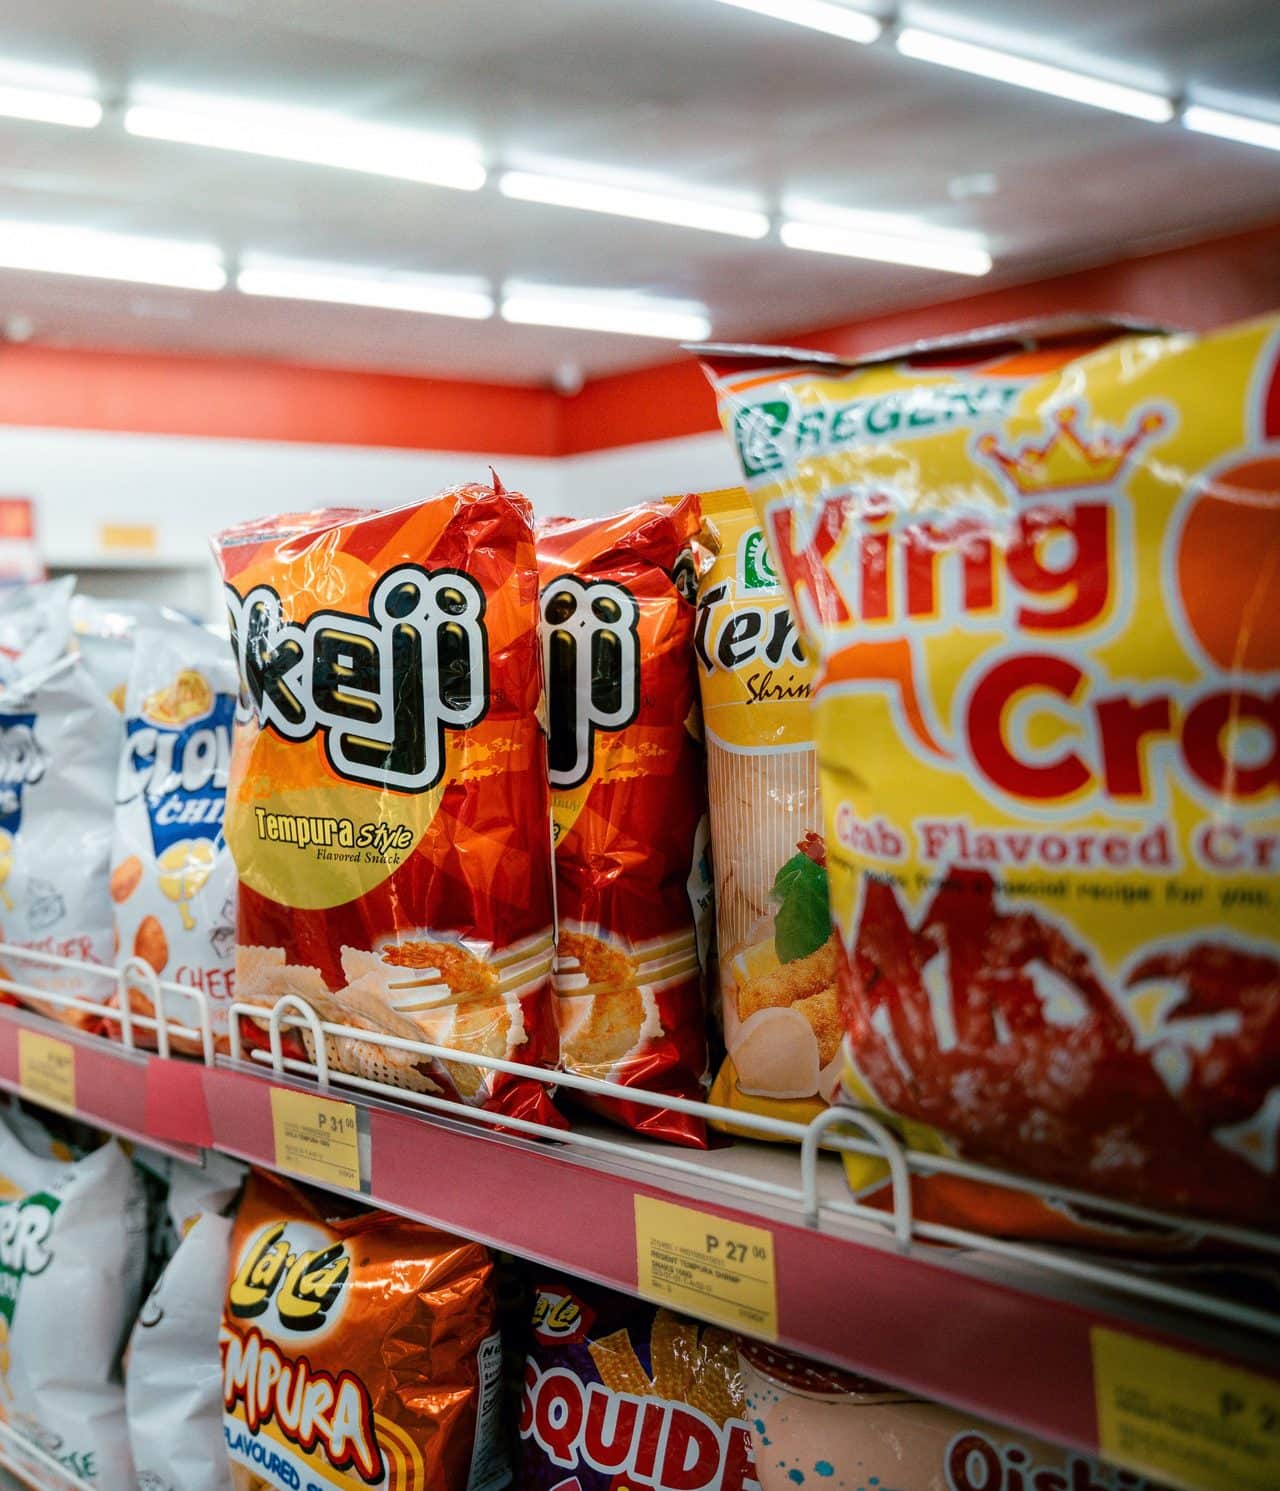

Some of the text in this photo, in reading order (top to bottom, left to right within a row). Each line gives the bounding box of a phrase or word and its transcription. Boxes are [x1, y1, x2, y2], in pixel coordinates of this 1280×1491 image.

[766, 494, 1117, 637] King
[224, 562, 489, 794] keji
[155, 797, 226, 827] CHI
[255, 806, 414, 855] Tempura Style
[837, 805, 903, 860] Crab
[921, 822, 1172, 866] Flavored
[316, 848, 401, 865] Flavored Snack
[318, 1112, 327, 1129] P
[705, 1234, 719, 1253] P
[726, 1240, 748, 1264] 27
[219, 1327, 384, 1485] MPURA
